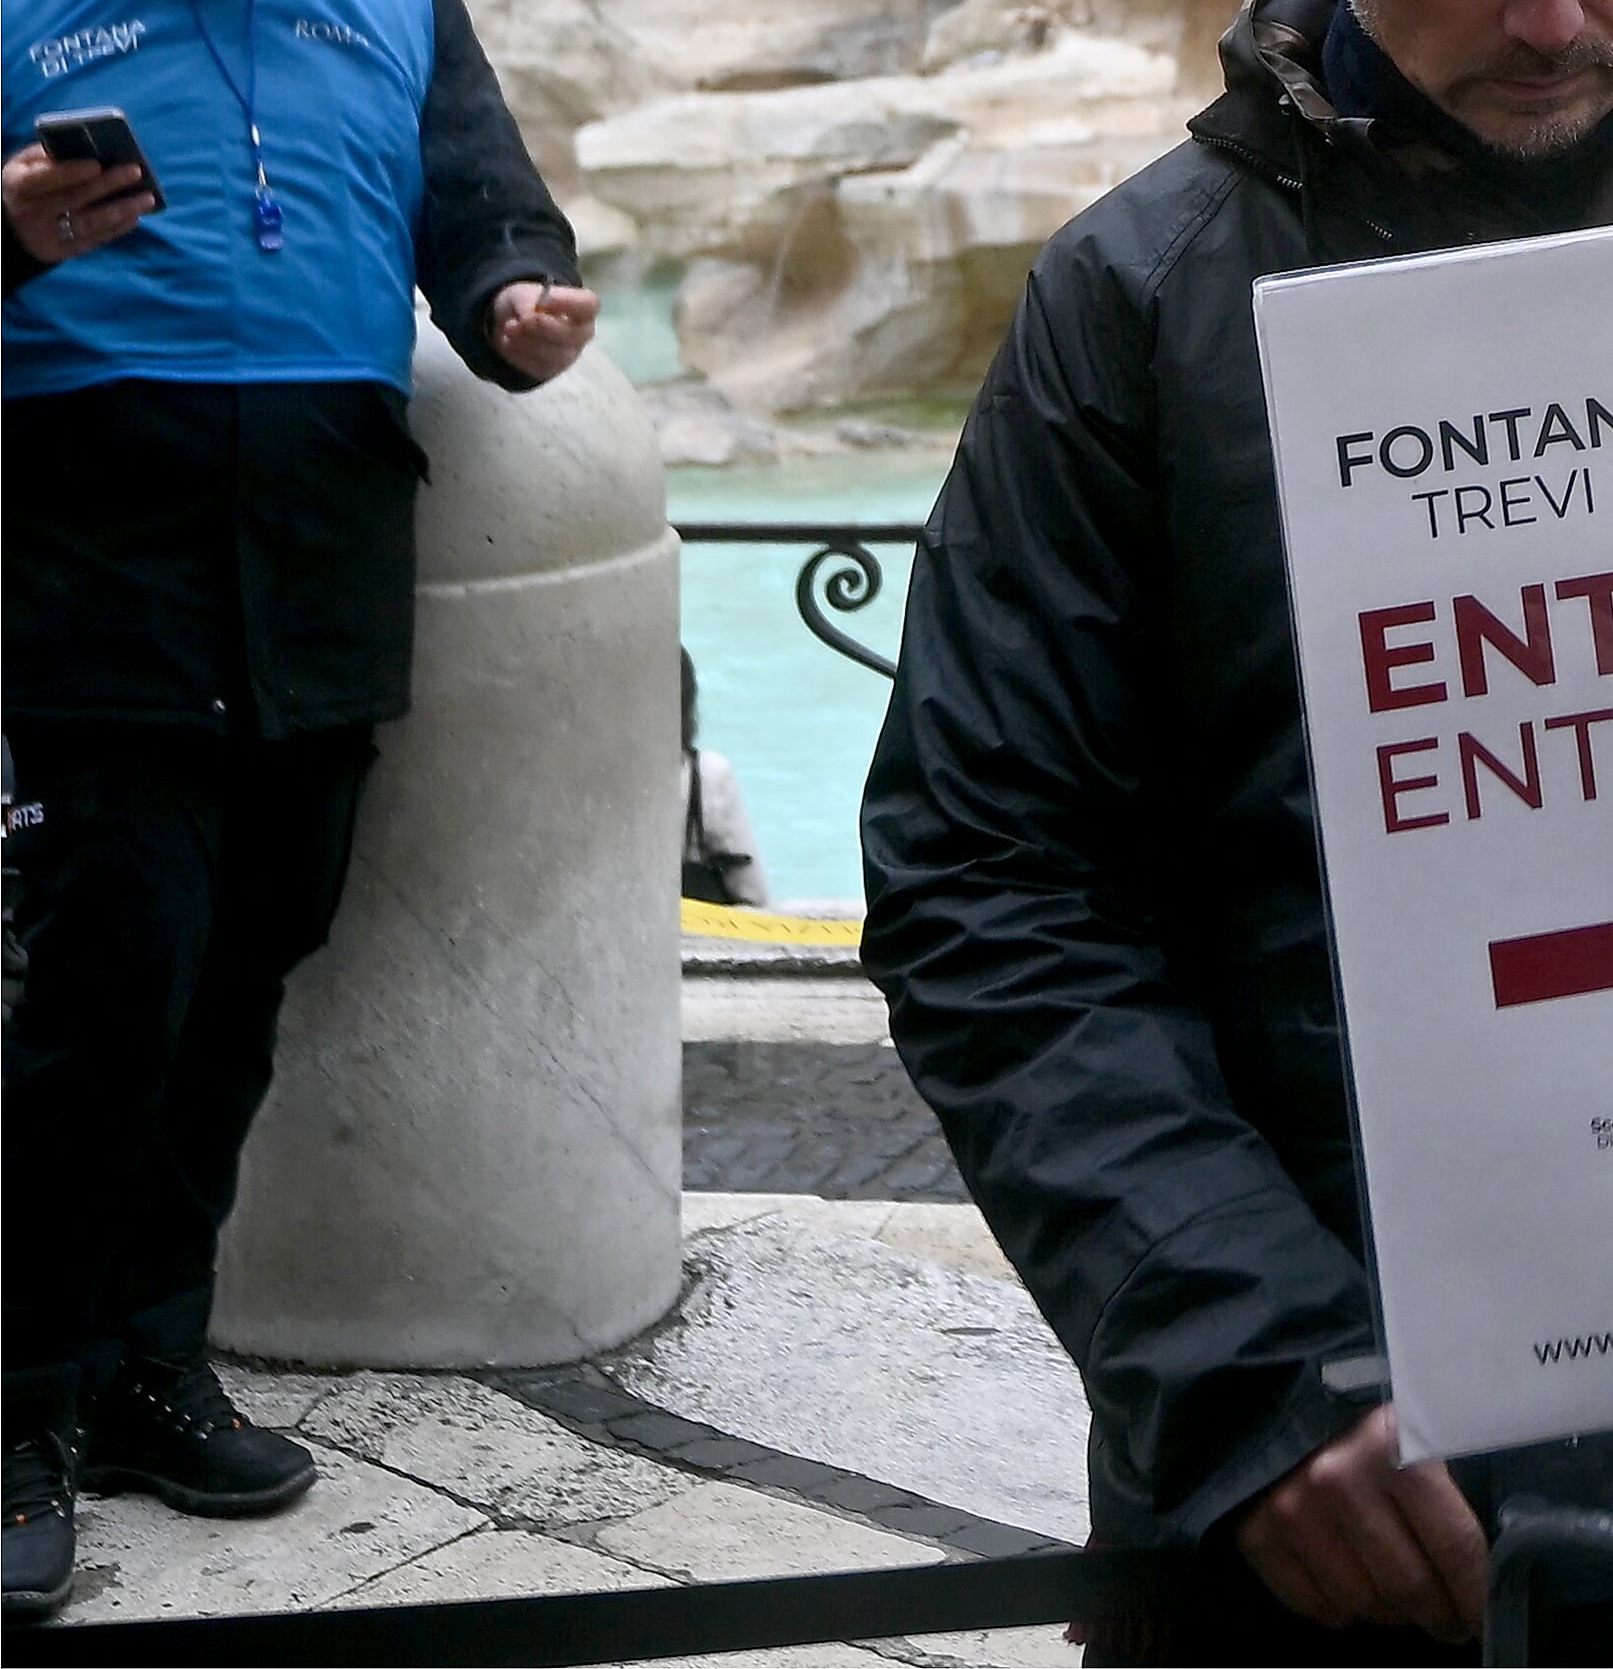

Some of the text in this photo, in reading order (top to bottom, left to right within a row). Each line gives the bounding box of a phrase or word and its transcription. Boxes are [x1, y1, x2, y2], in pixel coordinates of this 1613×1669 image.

[29, 19, 146, 63] FONTANA
[42, 56, 68, 77] DI
[1412, 467, 1596, 539] TREVI
